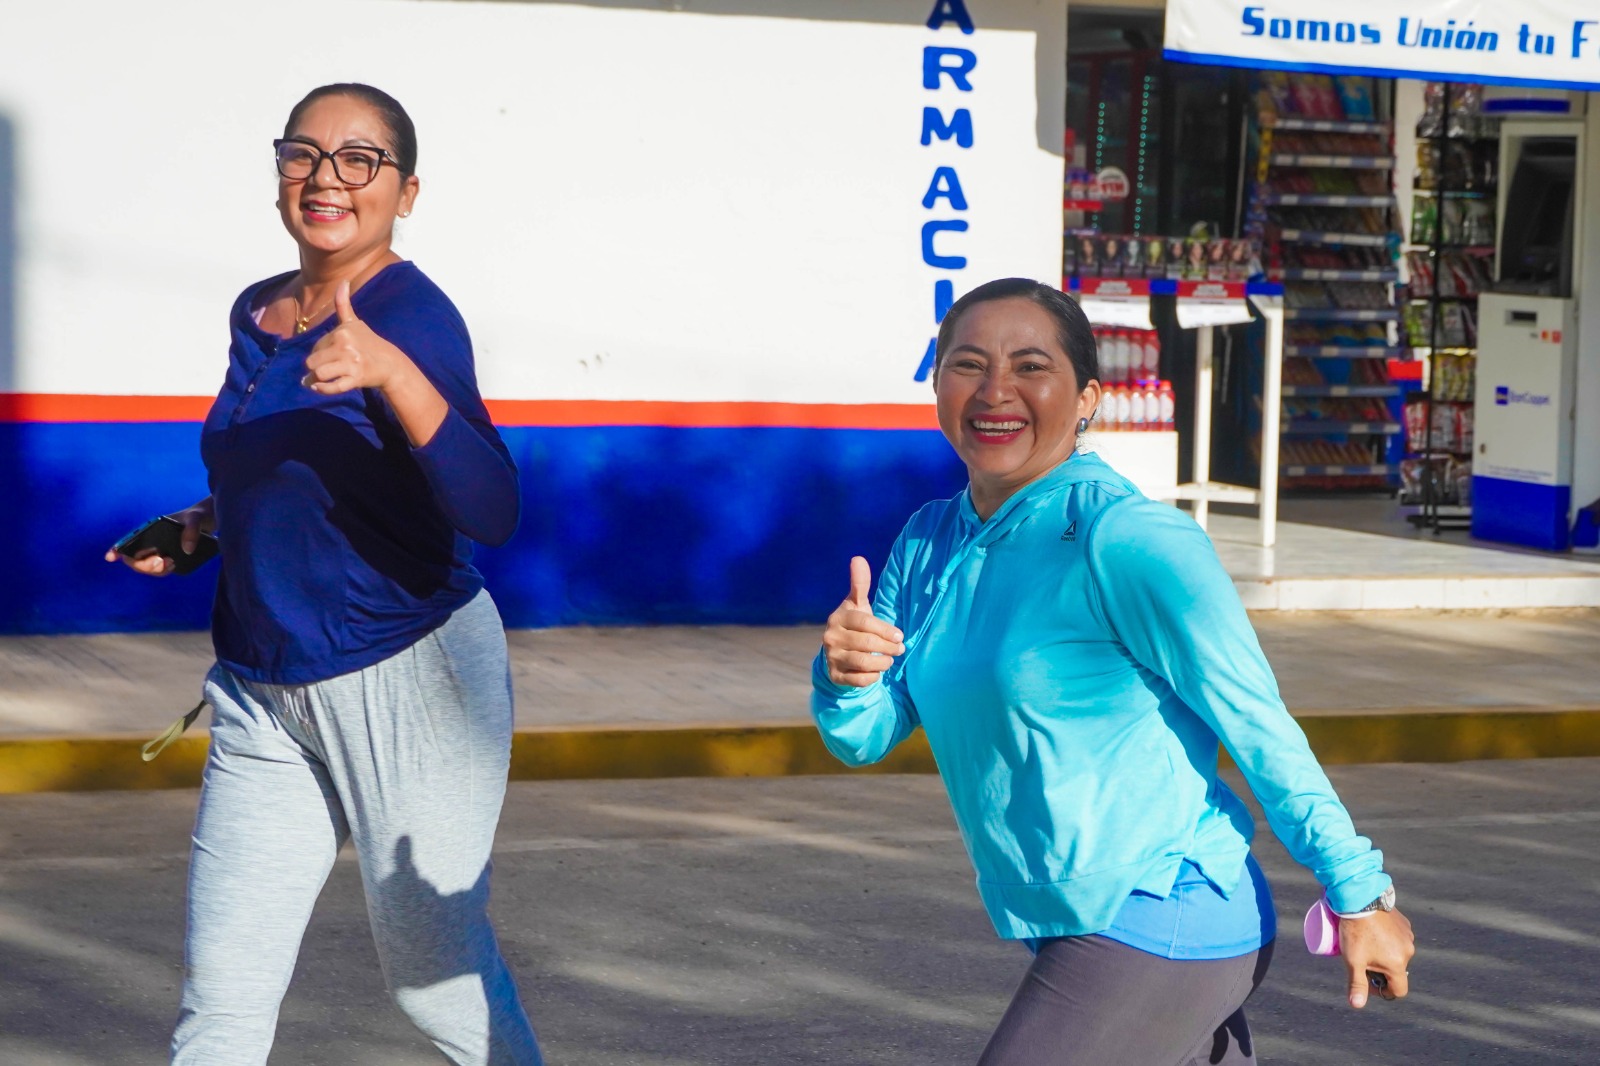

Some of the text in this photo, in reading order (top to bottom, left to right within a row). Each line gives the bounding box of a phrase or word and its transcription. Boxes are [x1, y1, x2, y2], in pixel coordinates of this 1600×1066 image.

[1241, 6, 1600, 59] Somos Unión tu F
